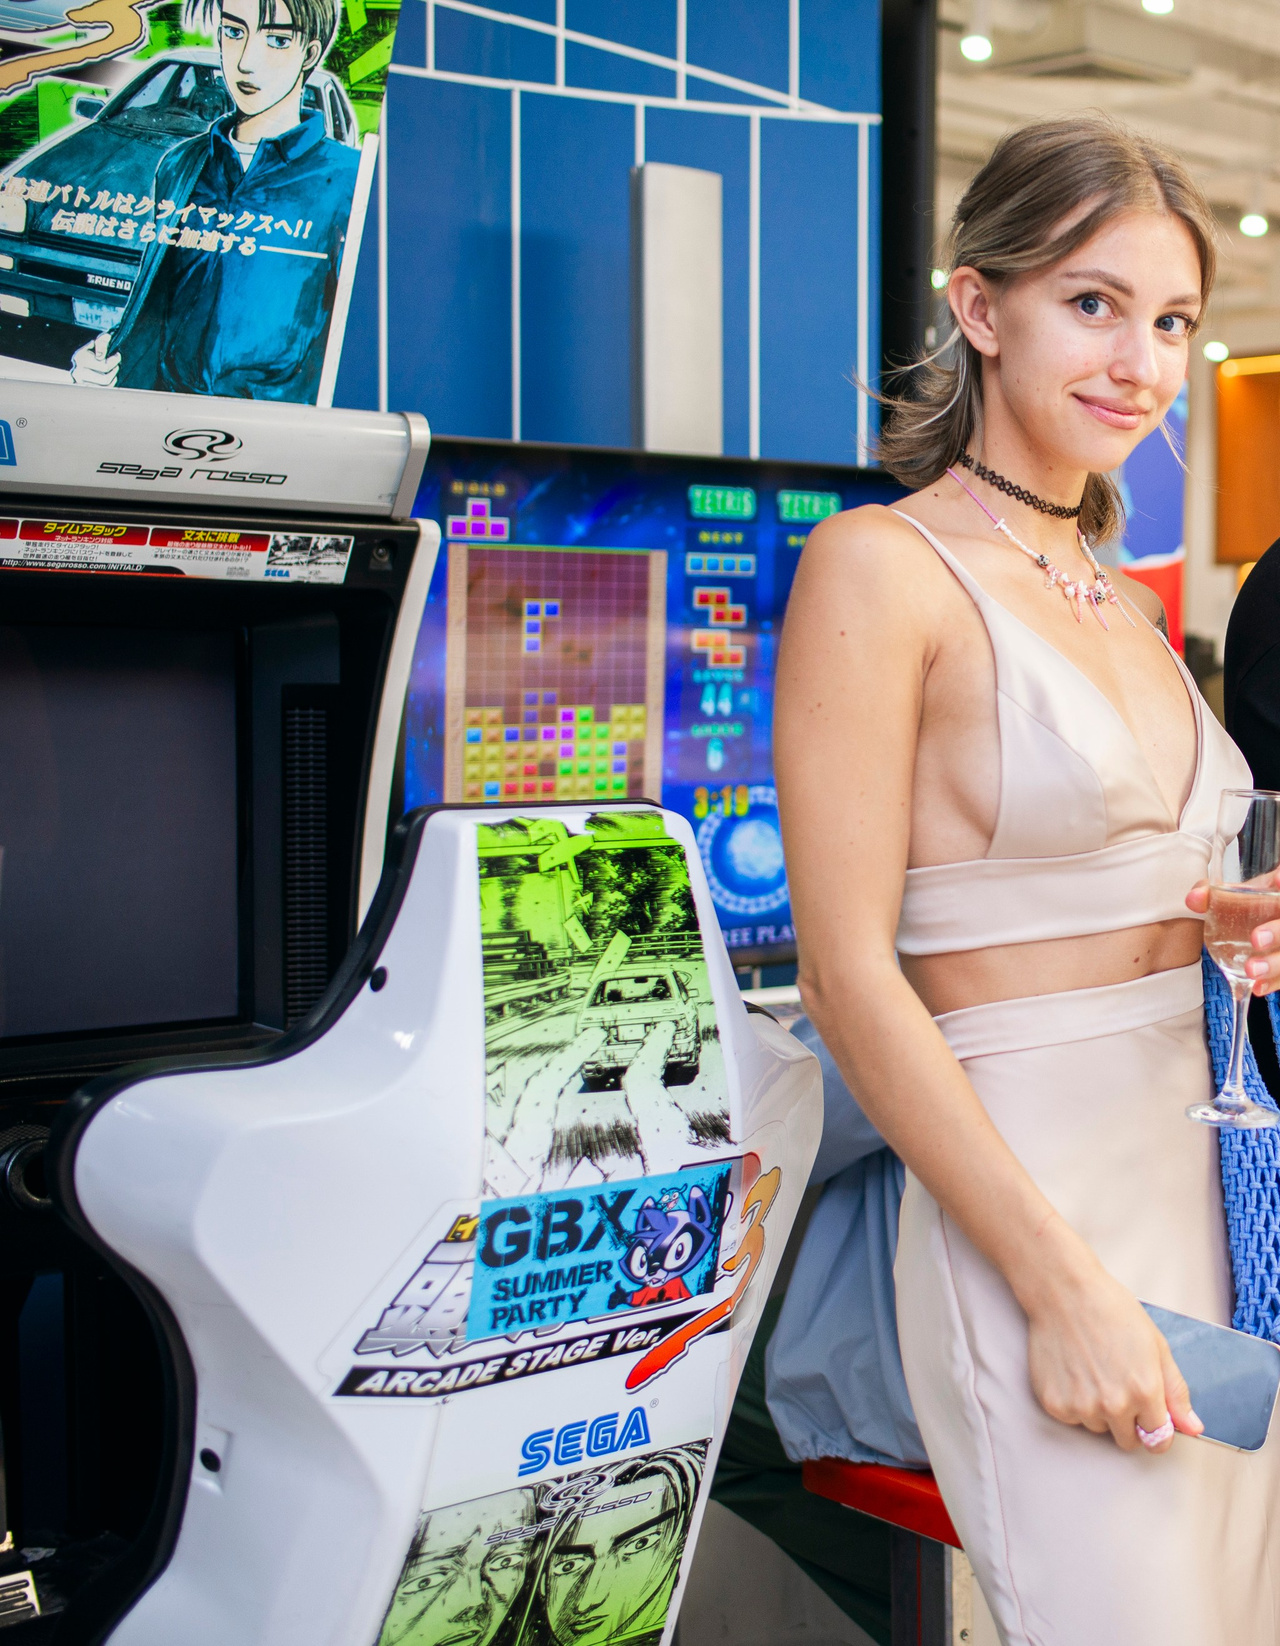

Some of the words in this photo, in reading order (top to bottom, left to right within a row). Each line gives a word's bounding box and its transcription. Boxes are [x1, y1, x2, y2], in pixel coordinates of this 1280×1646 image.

[86, 273, 132, 291] TRUENO
[96, 462, 183, 481] sega
[190, 468, 288, 485] rosso
[690, 486, 754, 518] TETRIS
[43, 522, 127, 537] タイムアタック
[264, 569, 290, 579] SEGA
[700, 675, 733, 718] 44
[478, 1187, 639, 1268] GBX
[492, 1260, 614, 1303] SUMMER
[490, 1289, 589, 1331] PARTY
[356, 1354, 504, 1394] ARCADE
[504, 1336, 606, 1378] STAGE
[609, 1324, 661, 1356] Ver.
[517, 1405, 651, 1478] SEGA
[484, 1515, 560, 1545] sega
[565, 1491, 653, 1523] rosso
